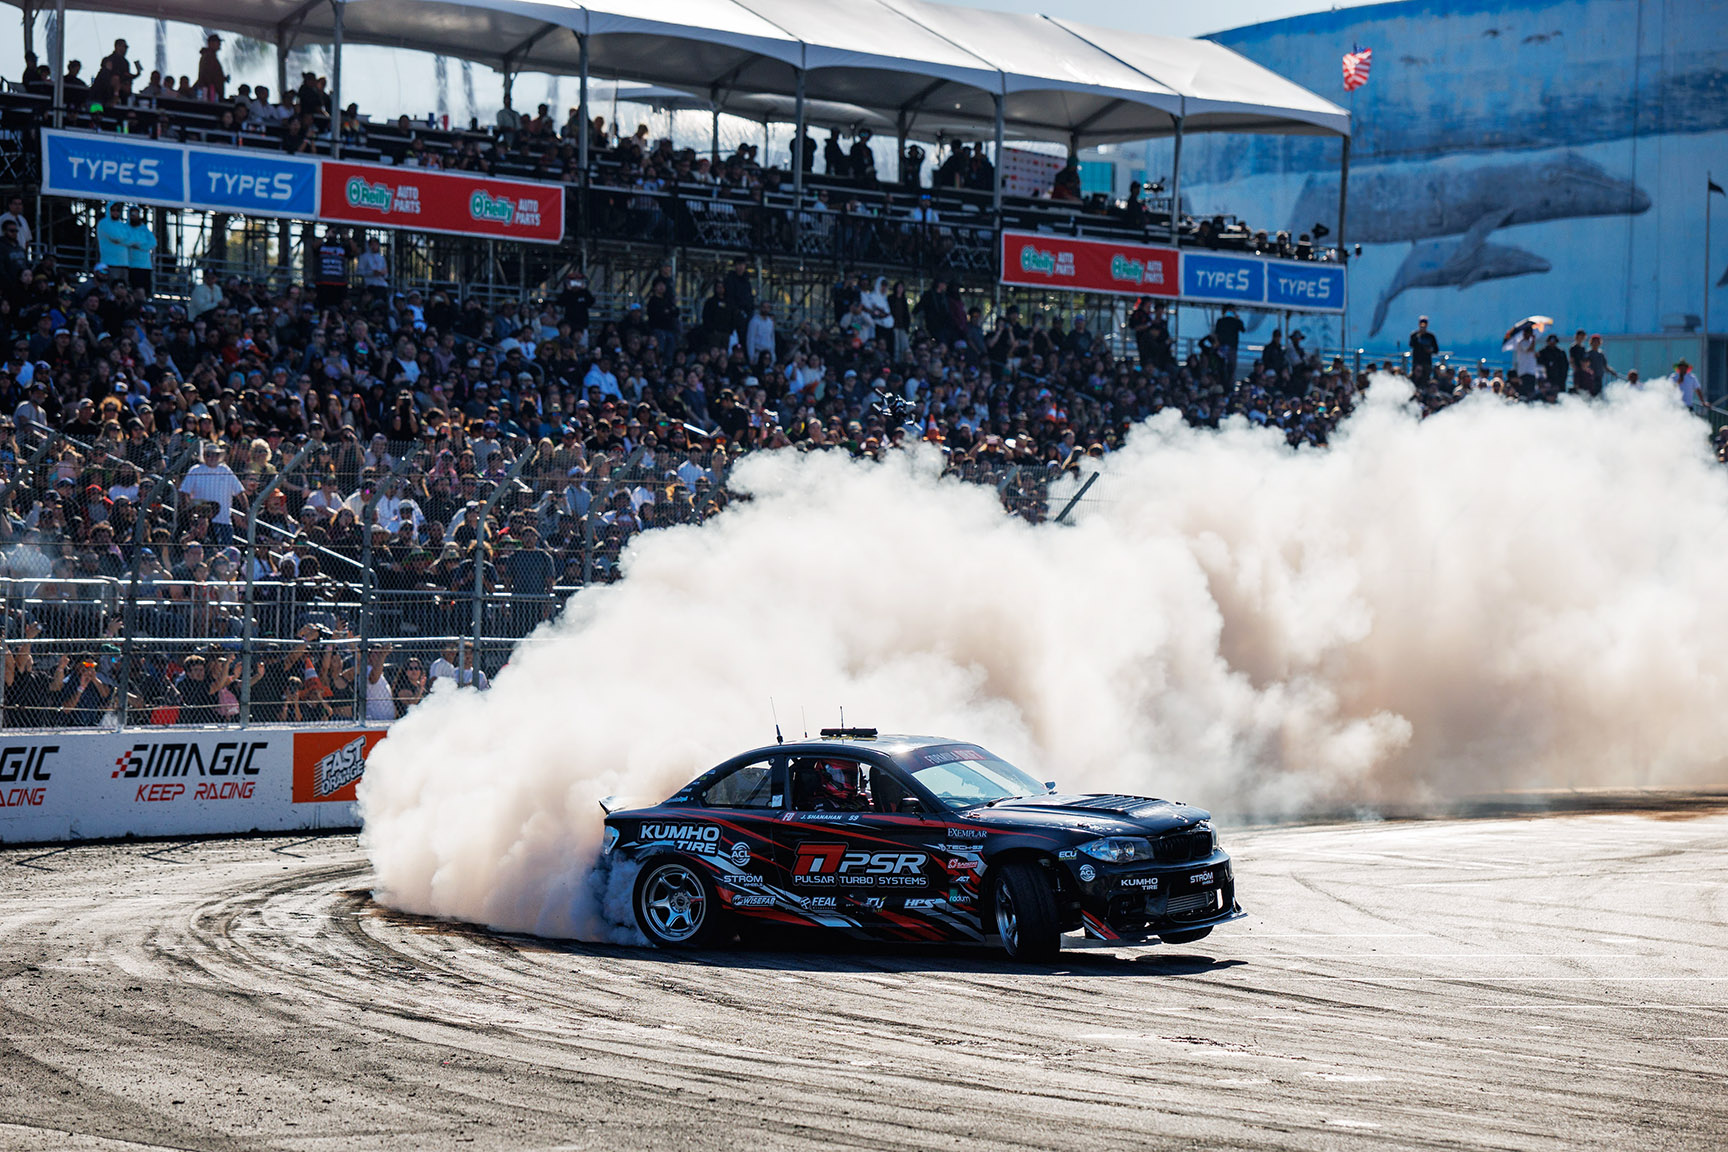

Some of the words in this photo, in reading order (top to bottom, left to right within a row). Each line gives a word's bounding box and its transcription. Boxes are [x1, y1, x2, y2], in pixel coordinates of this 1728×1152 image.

[396, 186, 419, 199] AUTO
[394, 199, 421, 214] PARTS
[518, 199, 539, 213] AUTO
[515, 213, 541, 227] PARTS
[123, 742, 268, 778] SIMAGIC
[322, 735, 366, 780] FAST
[321, 760, 365, 795] ORANGE
[134, 783, 186, 801] KEEP
[194, 782, 256, 800] RACING
[640, 825, 720, 841] KUMHO
[676, 840, 717, 854] TIRE
[731, 850, 751, 858] ACL
[1058, 850, 1078, 858] ECU
[838, 853, 927, 874] PSR
[795, 875, 835, 883] PULSAR
[839, 876, 874, 884] TURBO
[878, 877, 927, 885] SYSTEMS
[1120, 877, 1158, 886] KUMHO
[811, 897, 837, 906] FEAL
[904, 898, 936, 908] HPS
